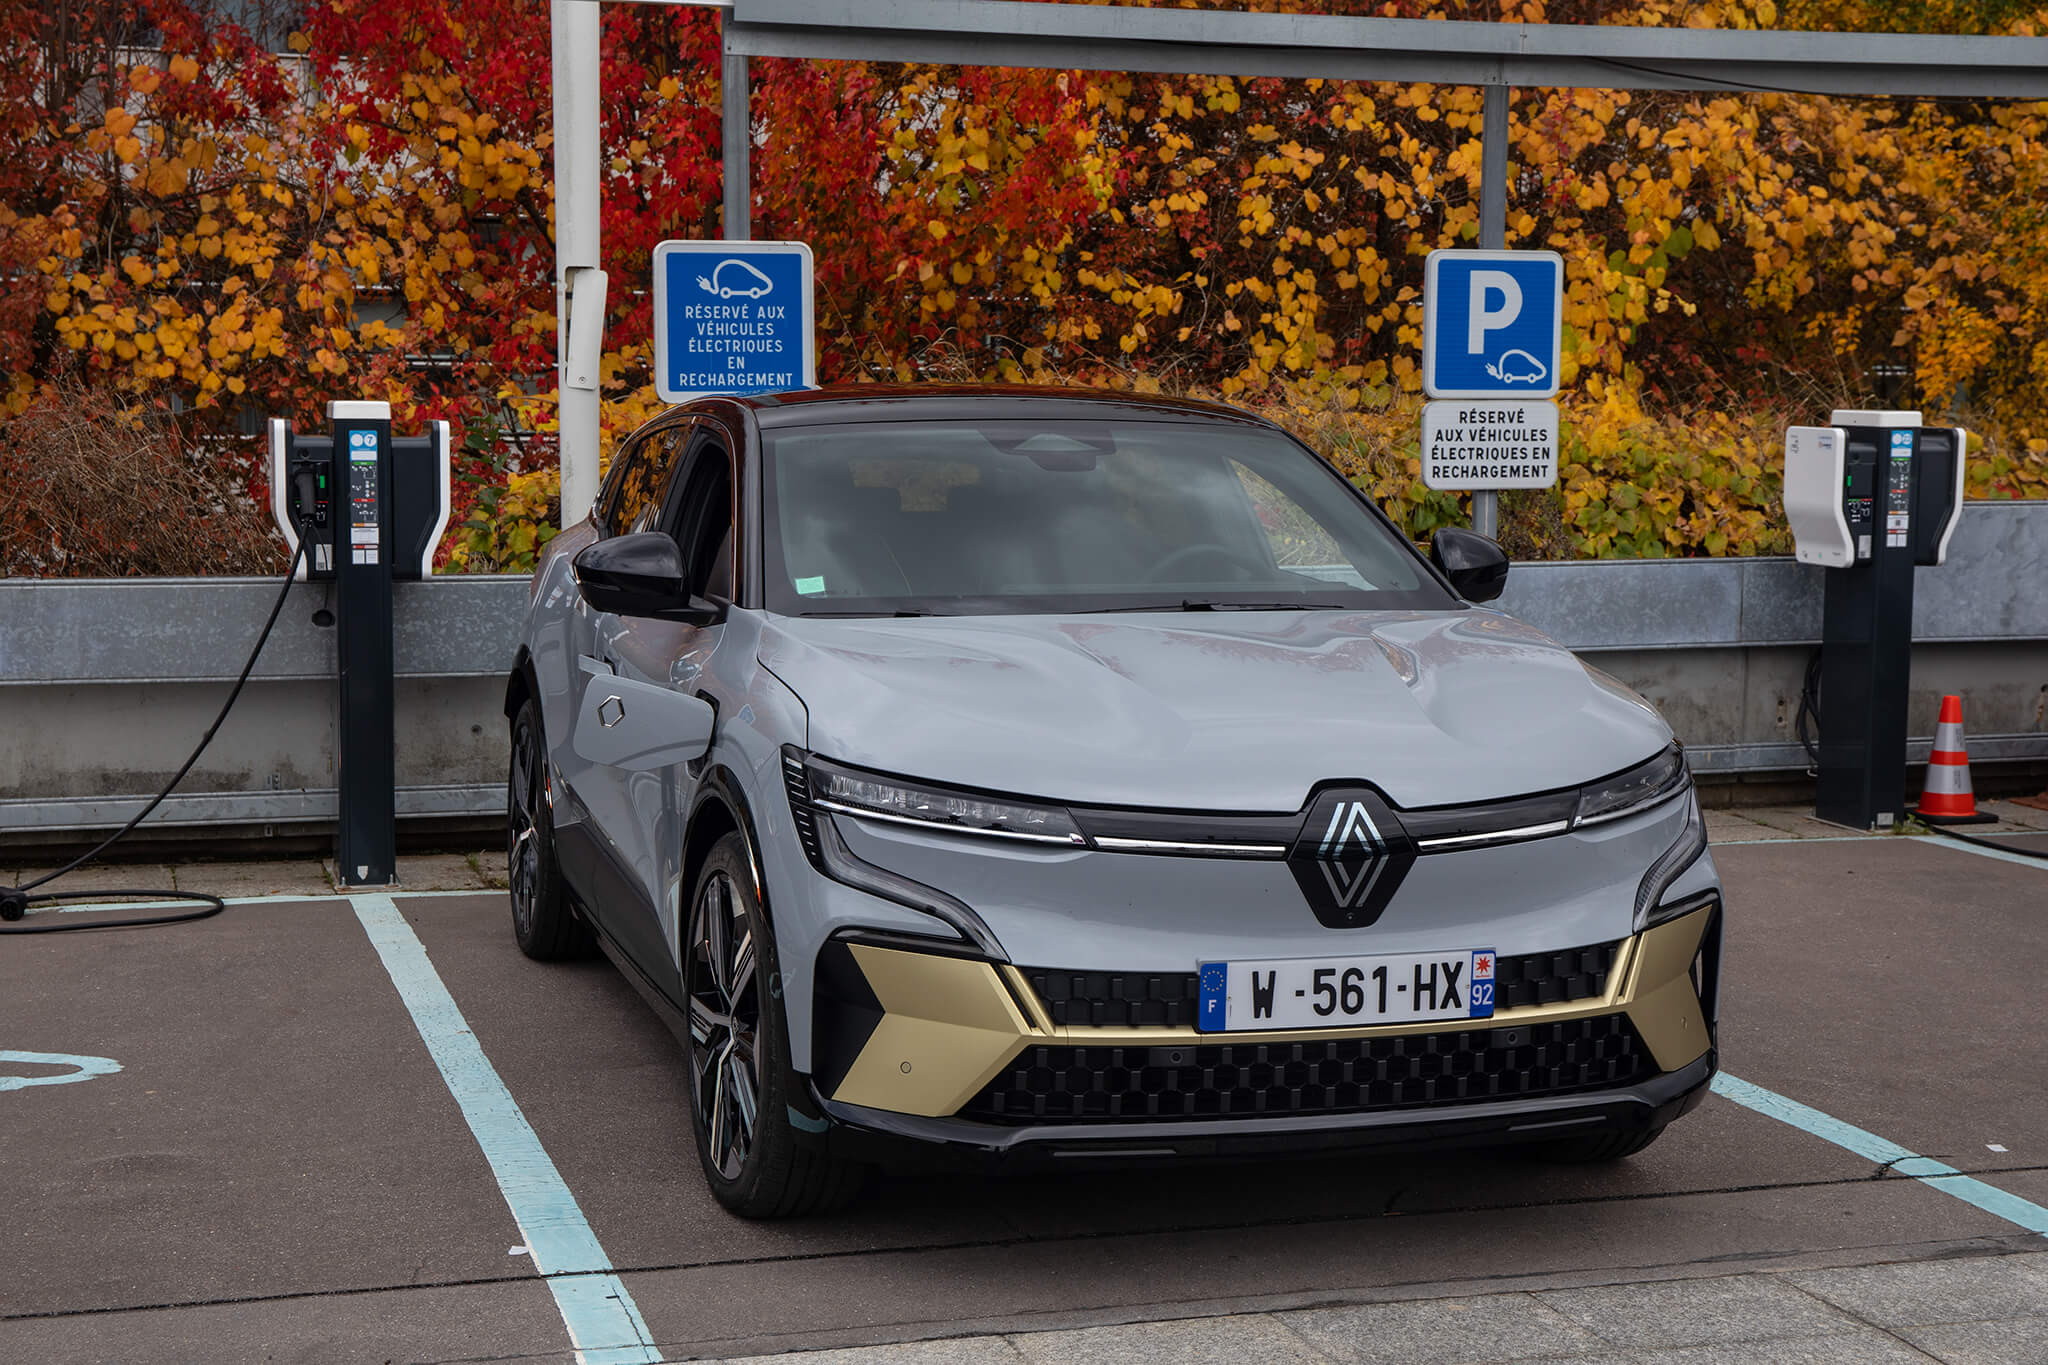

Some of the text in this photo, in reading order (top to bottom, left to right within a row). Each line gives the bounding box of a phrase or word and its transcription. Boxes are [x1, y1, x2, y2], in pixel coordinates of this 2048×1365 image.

[685, 303, 785, 319] RÉSERVÉ AUX
[1468, 269, 1523, 354] P
[697, 320, 775, 336] VÉHICULES
[688, 337, 783, 353] ÉLECTRIQUES
[728, 356, 745, 369] EN
[679, 373, 793, 386] RECHARGEMENT
[1459, 407, 1525, 424] RÉSERVÉ
[1435, 426, 1548, 442] AUX VÉHICULES
[1431, 444, 1550, 460] ÉLECTRIQUES EN
[1432, 465, 1549, 478] RECHARGEMENT
[1472, 983, 1493, 1006] 92
[1208, 999, 1217, 1014] F
